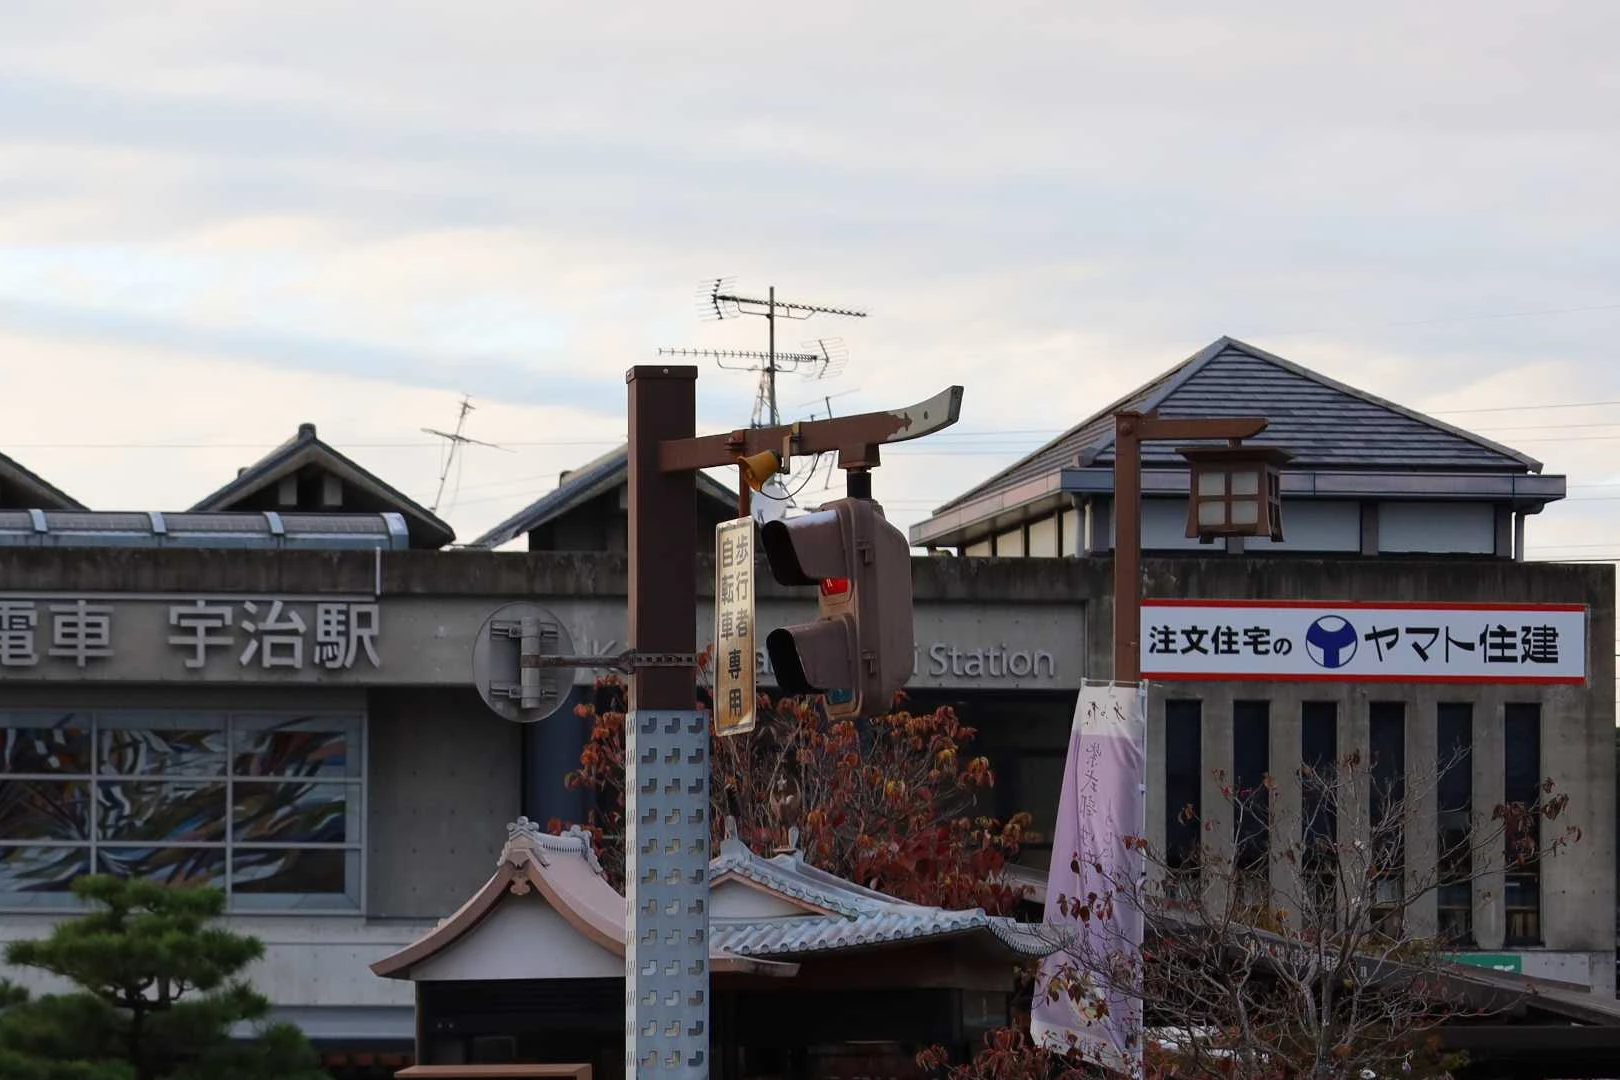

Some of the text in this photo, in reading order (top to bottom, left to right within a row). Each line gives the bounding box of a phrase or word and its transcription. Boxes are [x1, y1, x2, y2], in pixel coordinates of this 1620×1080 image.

[720, 538, 735, 641] 自転車
[735, 533, 749, 638] 歩行者
[168, 598, 381, 669] 宇治駅
[930, 642, 1056, 677] Station
[1147, 623, 1560, 665] 注文住宅の ヤマト住建
[727, 648, 742, 717] 専用
